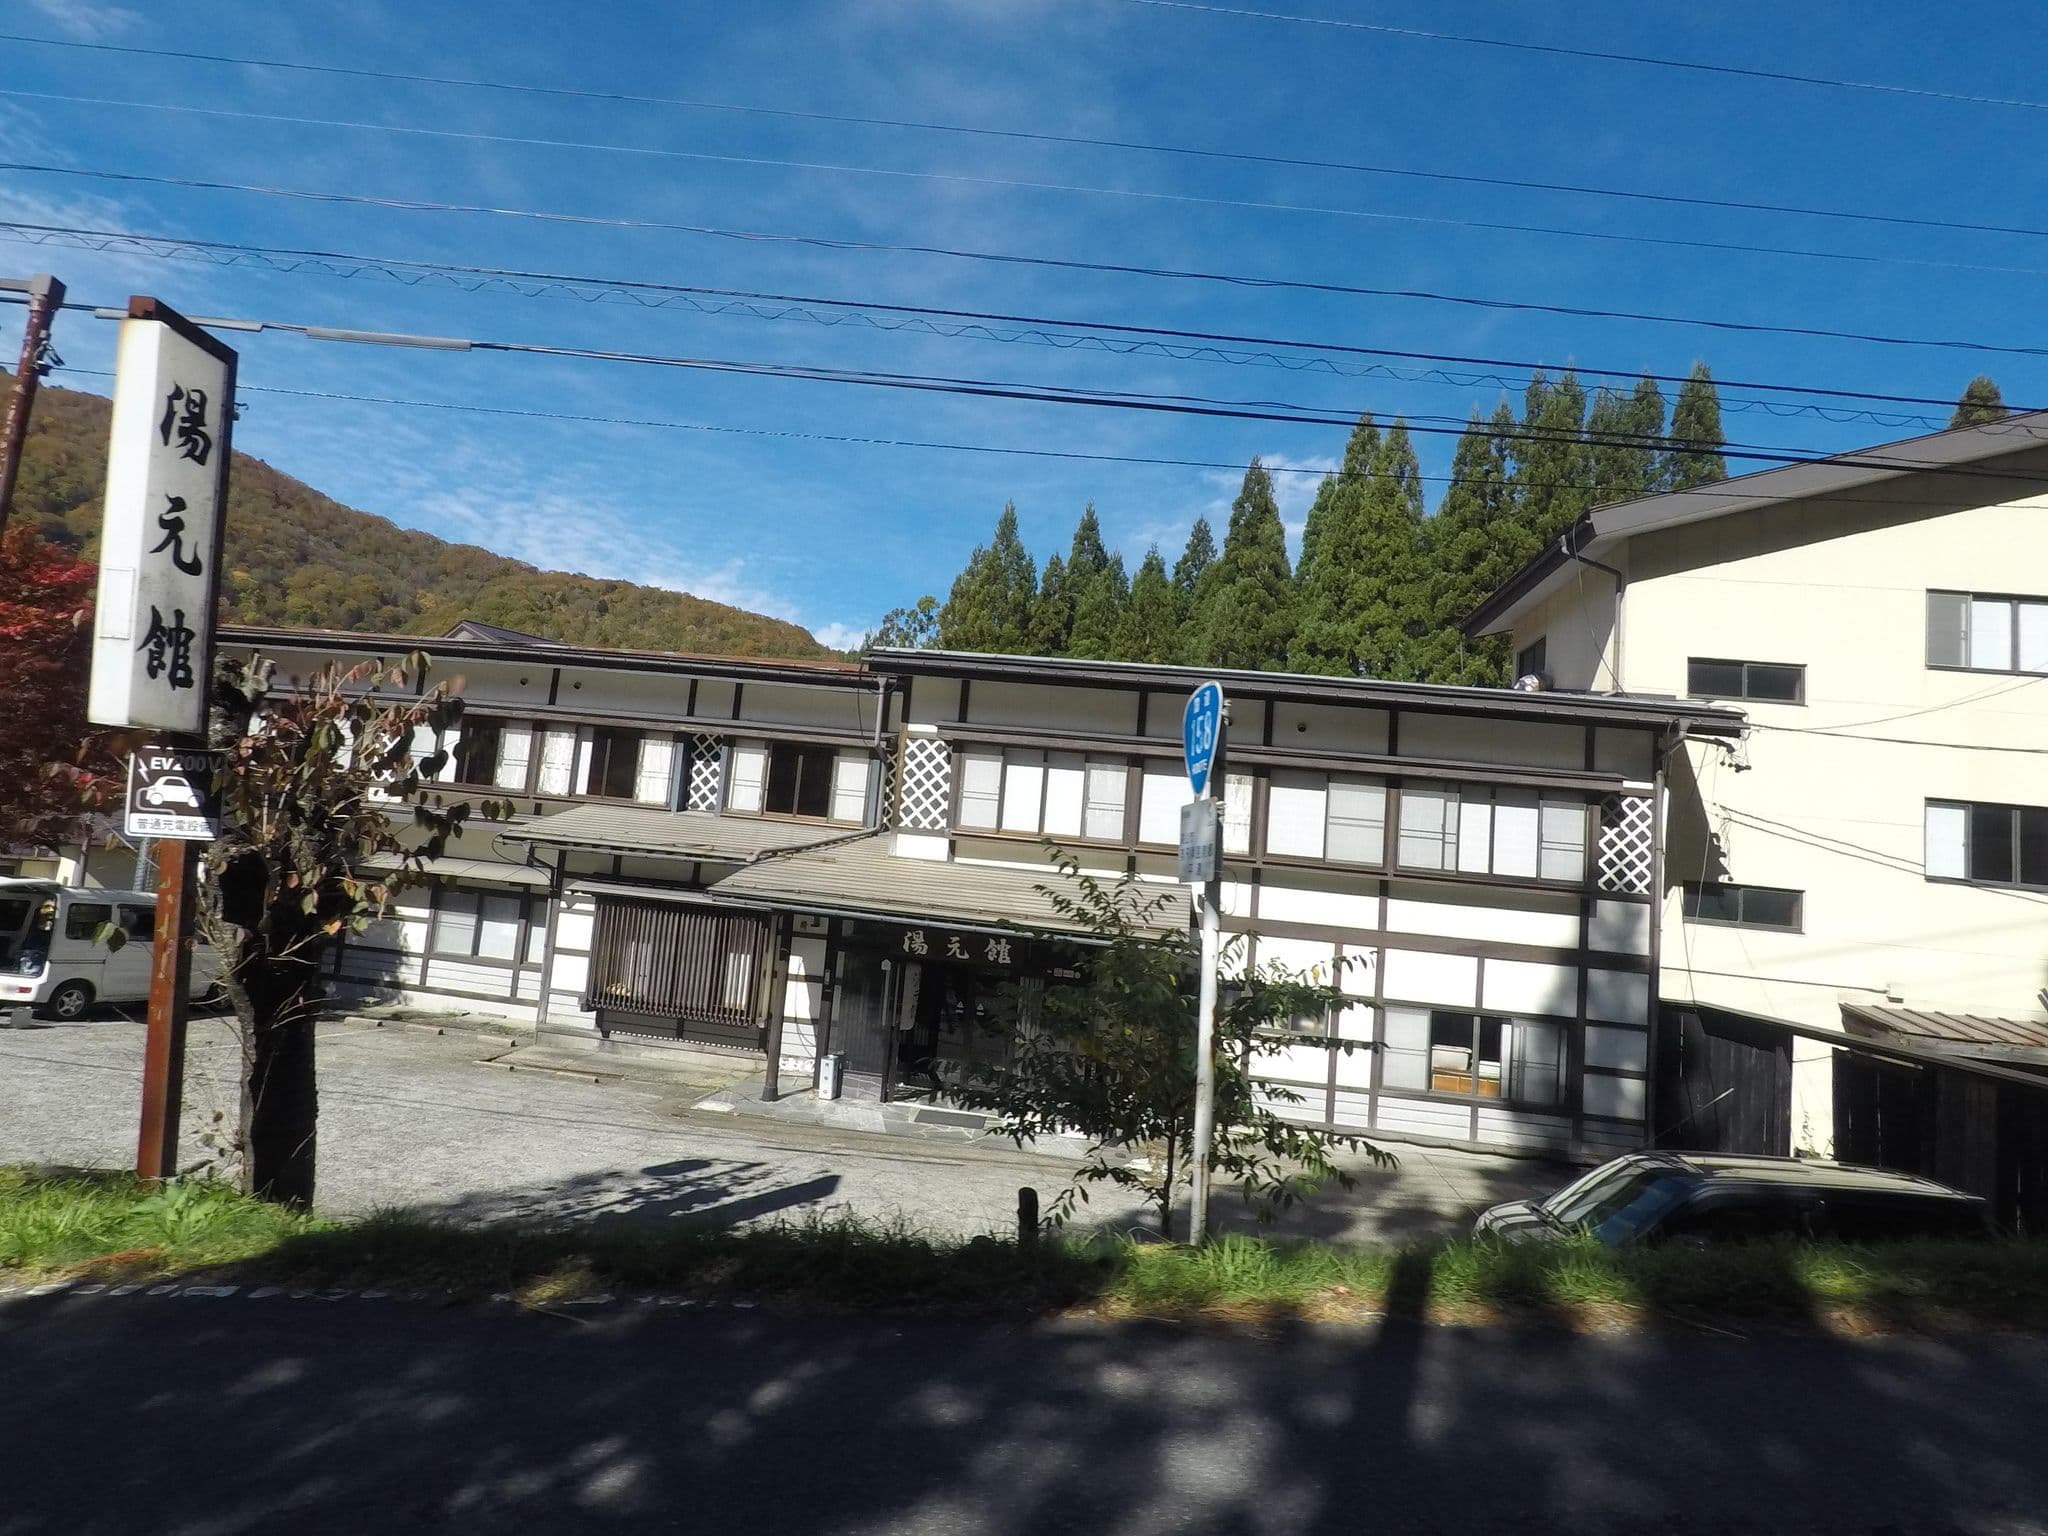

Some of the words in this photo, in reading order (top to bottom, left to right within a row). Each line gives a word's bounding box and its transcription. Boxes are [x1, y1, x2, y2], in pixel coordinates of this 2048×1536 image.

[138, 382, 212, 690] 湯元館
[1191, 710, 1211, 756] 158
[903, 930, 1011, 964] 湯元館
